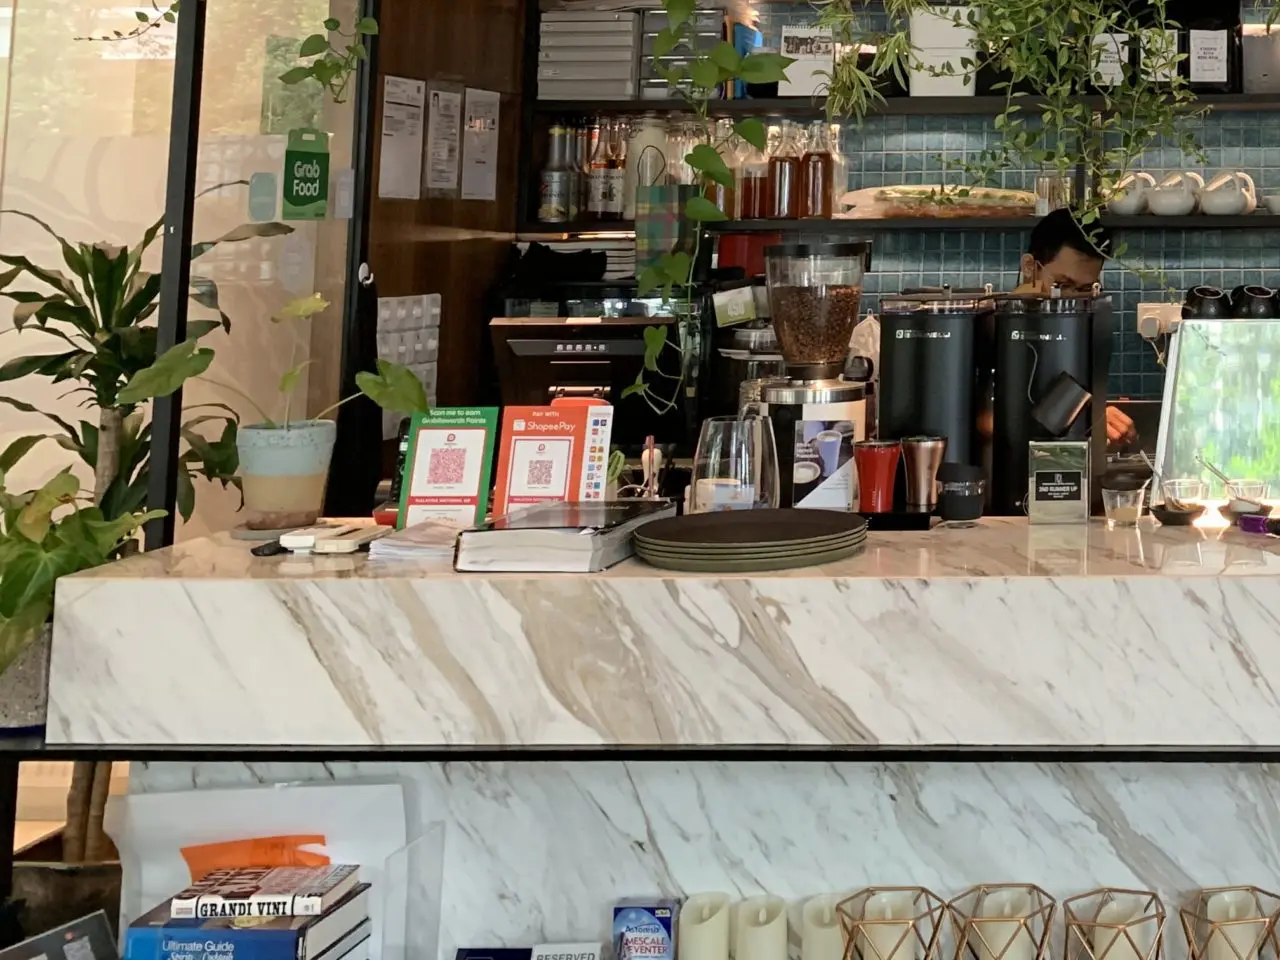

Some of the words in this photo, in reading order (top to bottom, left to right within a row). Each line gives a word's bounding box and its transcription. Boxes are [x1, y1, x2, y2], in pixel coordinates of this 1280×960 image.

[294, 160, 320, 178] Grab
[293, 179, 319, 196] Food
[527, 421, 576, 432] ShopeePay
[200, 902, 252, 917] GRANDI
[257, 901, 287, 916] VINI
[162, 940, 203, 951] Ultimate
[204, 940, 235, 951] Guide
